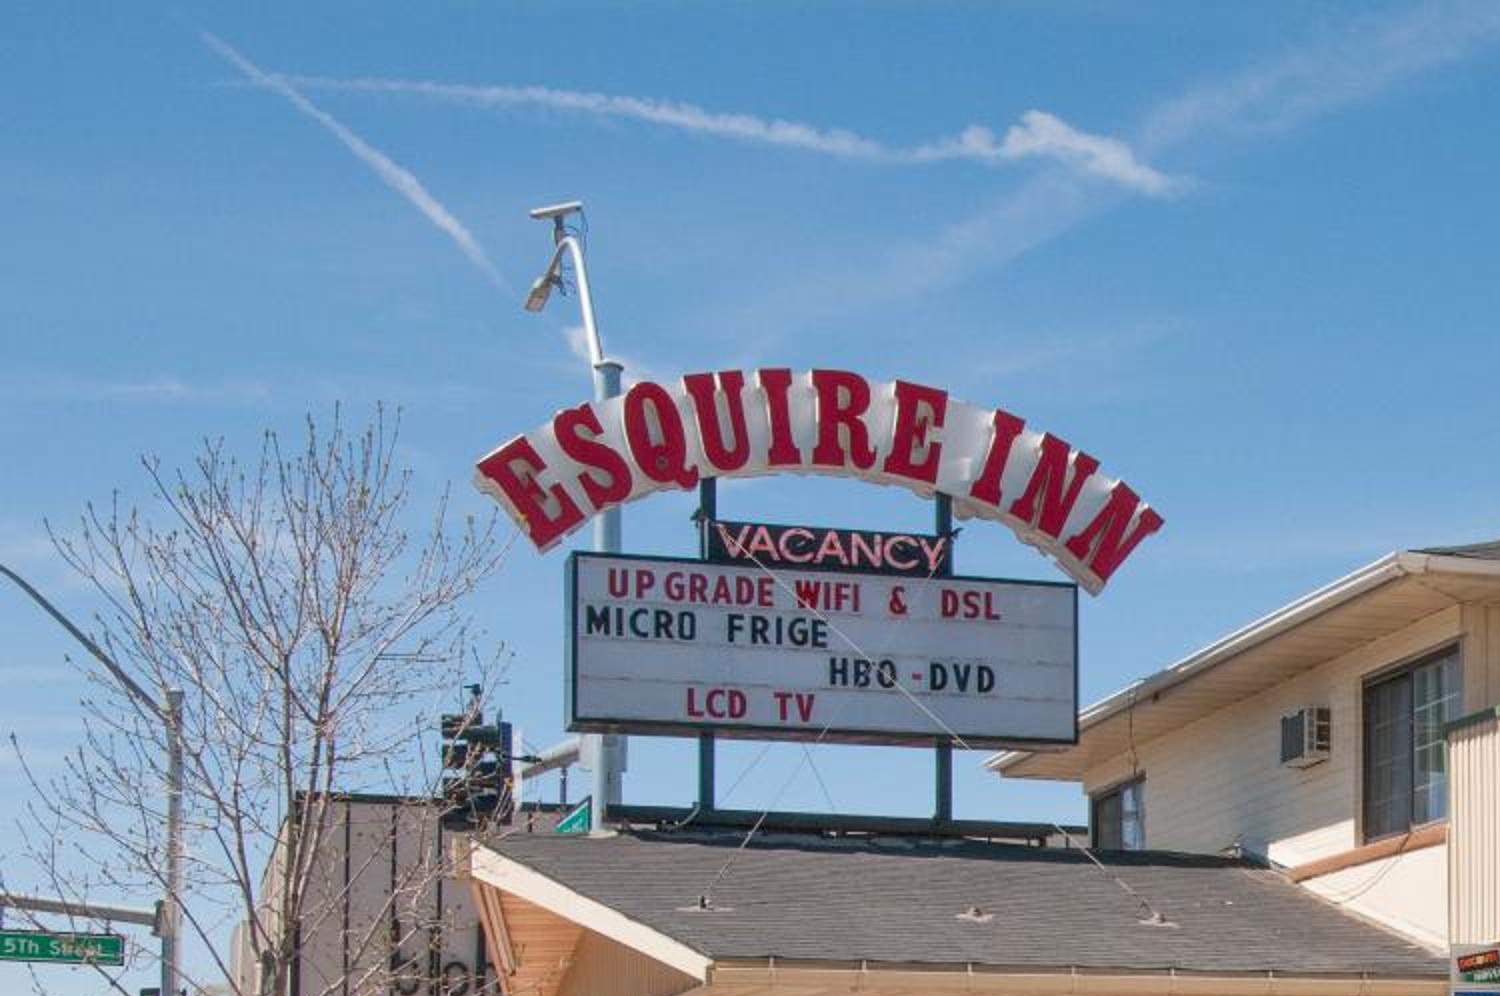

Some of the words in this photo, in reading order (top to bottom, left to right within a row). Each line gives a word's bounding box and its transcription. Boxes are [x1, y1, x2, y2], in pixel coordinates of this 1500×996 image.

[476, 367, 949, 549] ESQUIRE
[969, 408, 1166, 585] INN
[715, 523, 948, 571] VACANCY
[607, 567, 775, 608] UPGRADE
[794, 579, 862, 612] WIFI
[888, 584, 908, 615] &
[941, 588, 1002, 621] DSL
[585, 605, 697, 641] MICRO
[727, 613, 829, 648] FRIGE
[829, 657, 898, 689] HBO
[686, 687, 748, 719] LCD
[773, 691, 815, 722] TV
